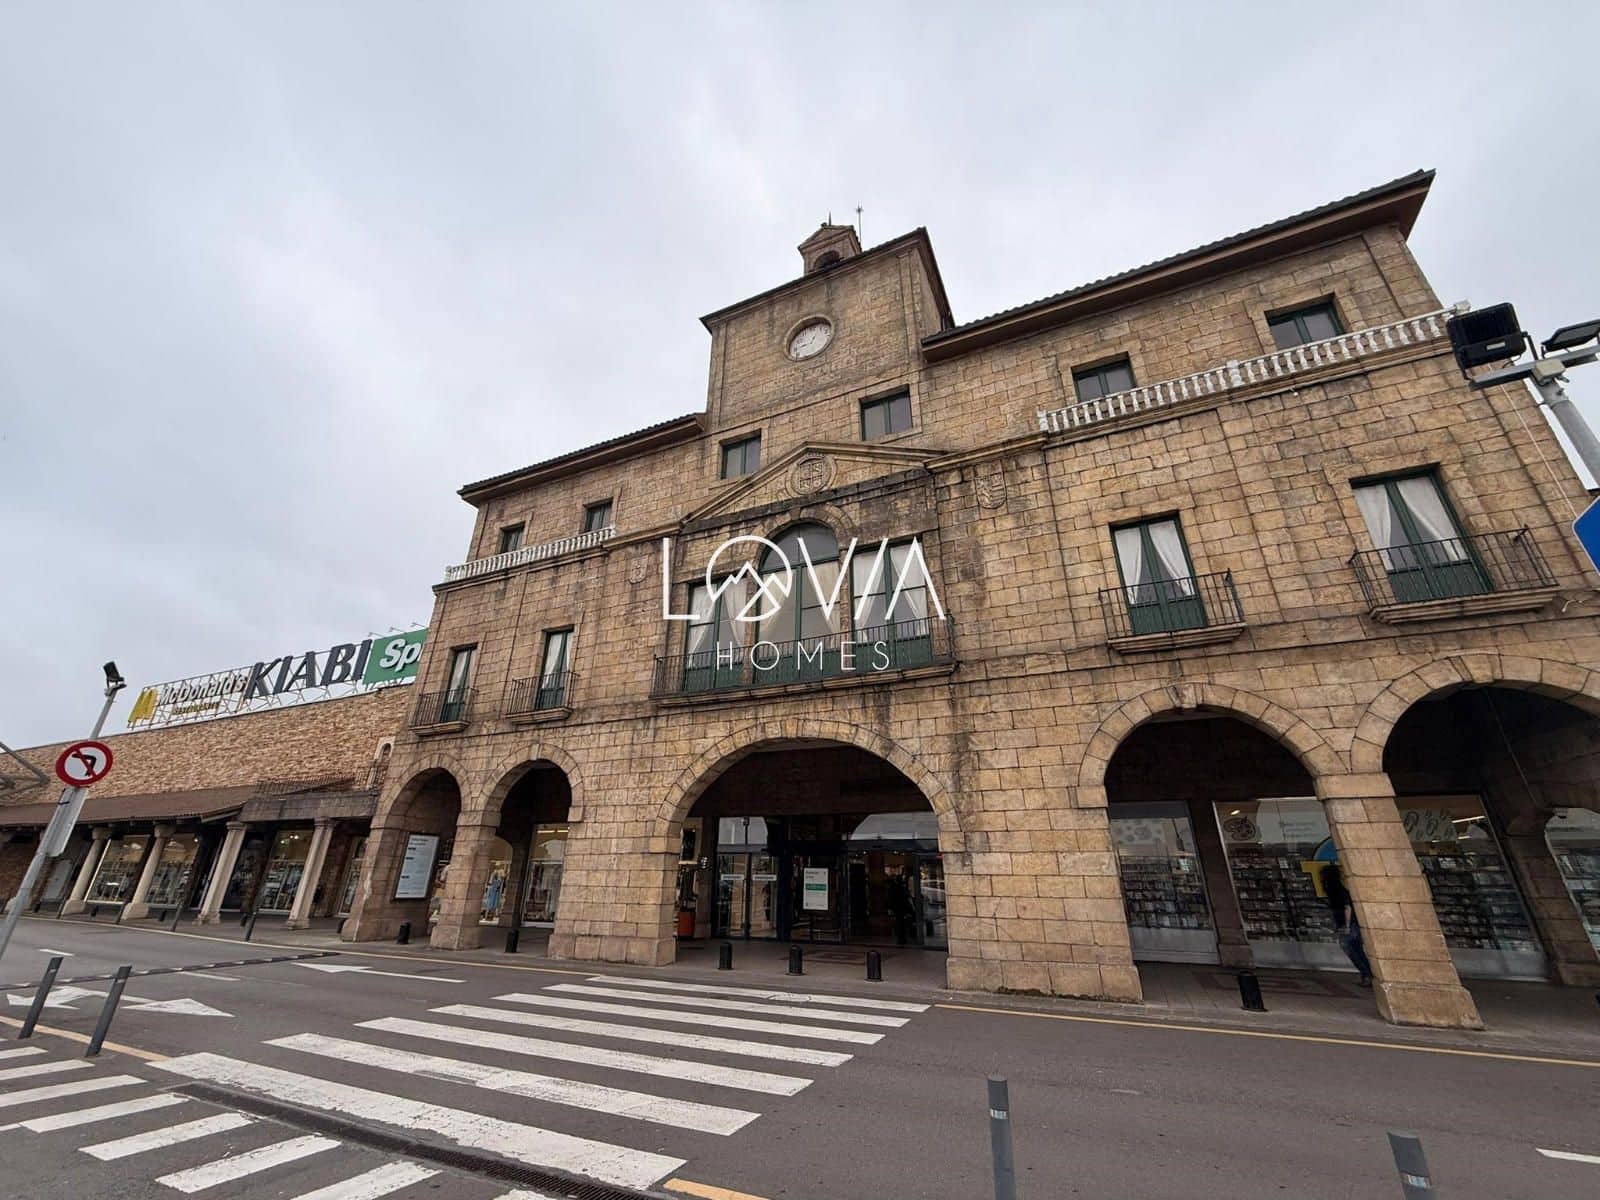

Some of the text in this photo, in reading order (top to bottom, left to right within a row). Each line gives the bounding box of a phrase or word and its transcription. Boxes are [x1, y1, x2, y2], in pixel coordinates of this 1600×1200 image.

[248, 639, 372, 699] KIABI
[379, 638, 423, 672] Sp
[158, 673, 248, 706] McDonald's
